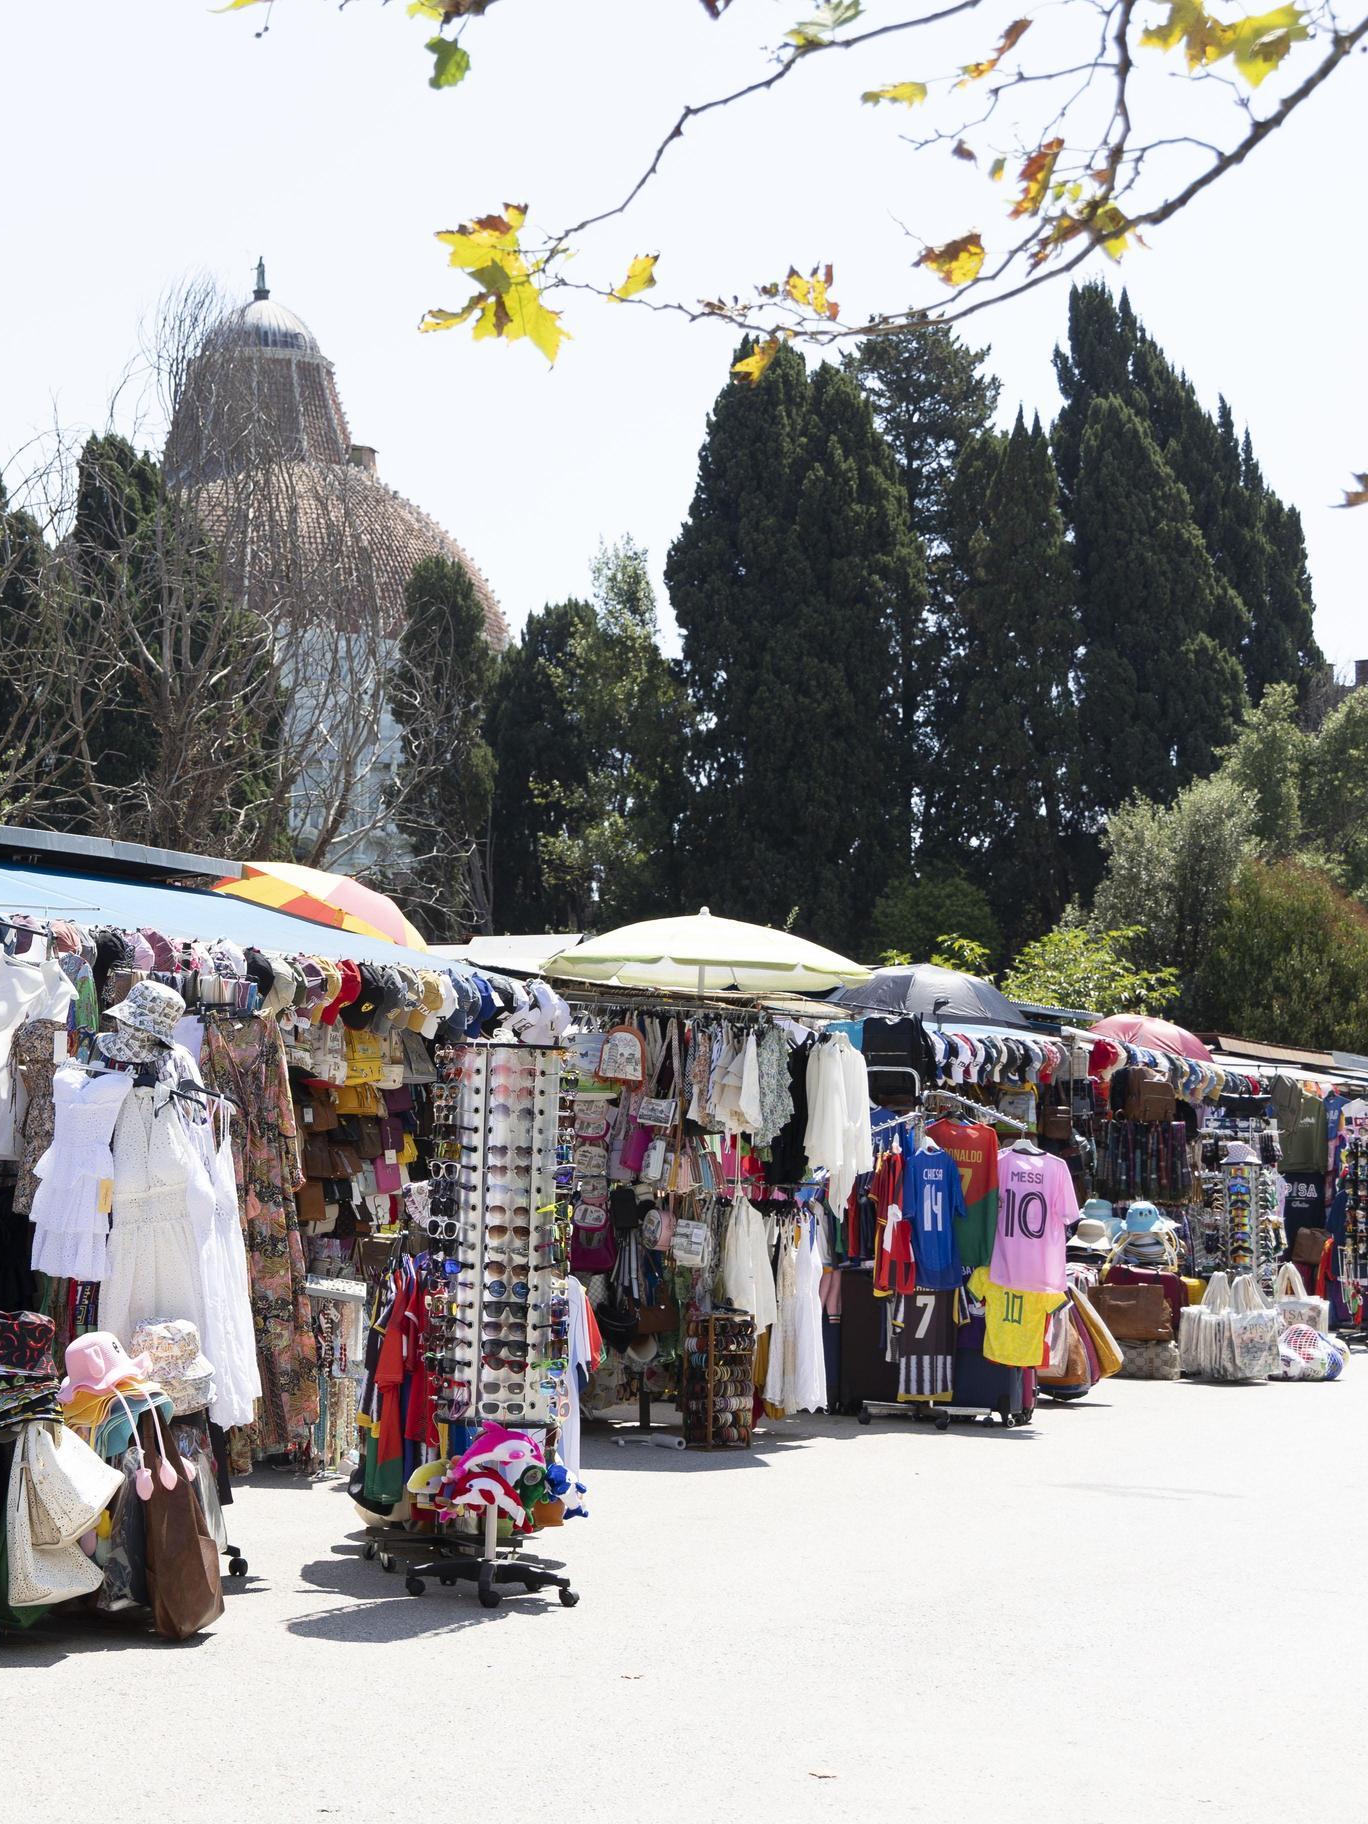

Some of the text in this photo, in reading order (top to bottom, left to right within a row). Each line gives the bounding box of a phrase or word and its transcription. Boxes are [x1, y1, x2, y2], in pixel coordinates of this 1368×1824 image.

[1011, 1171, 1044, 1184] MESSI
[923, 1184, 942, 1231] 14
[1005, 1188, 1047, 1239] 10
[915, 1295, 935, 1338] 7
[1002, 1291, 1024, 1325] 10
